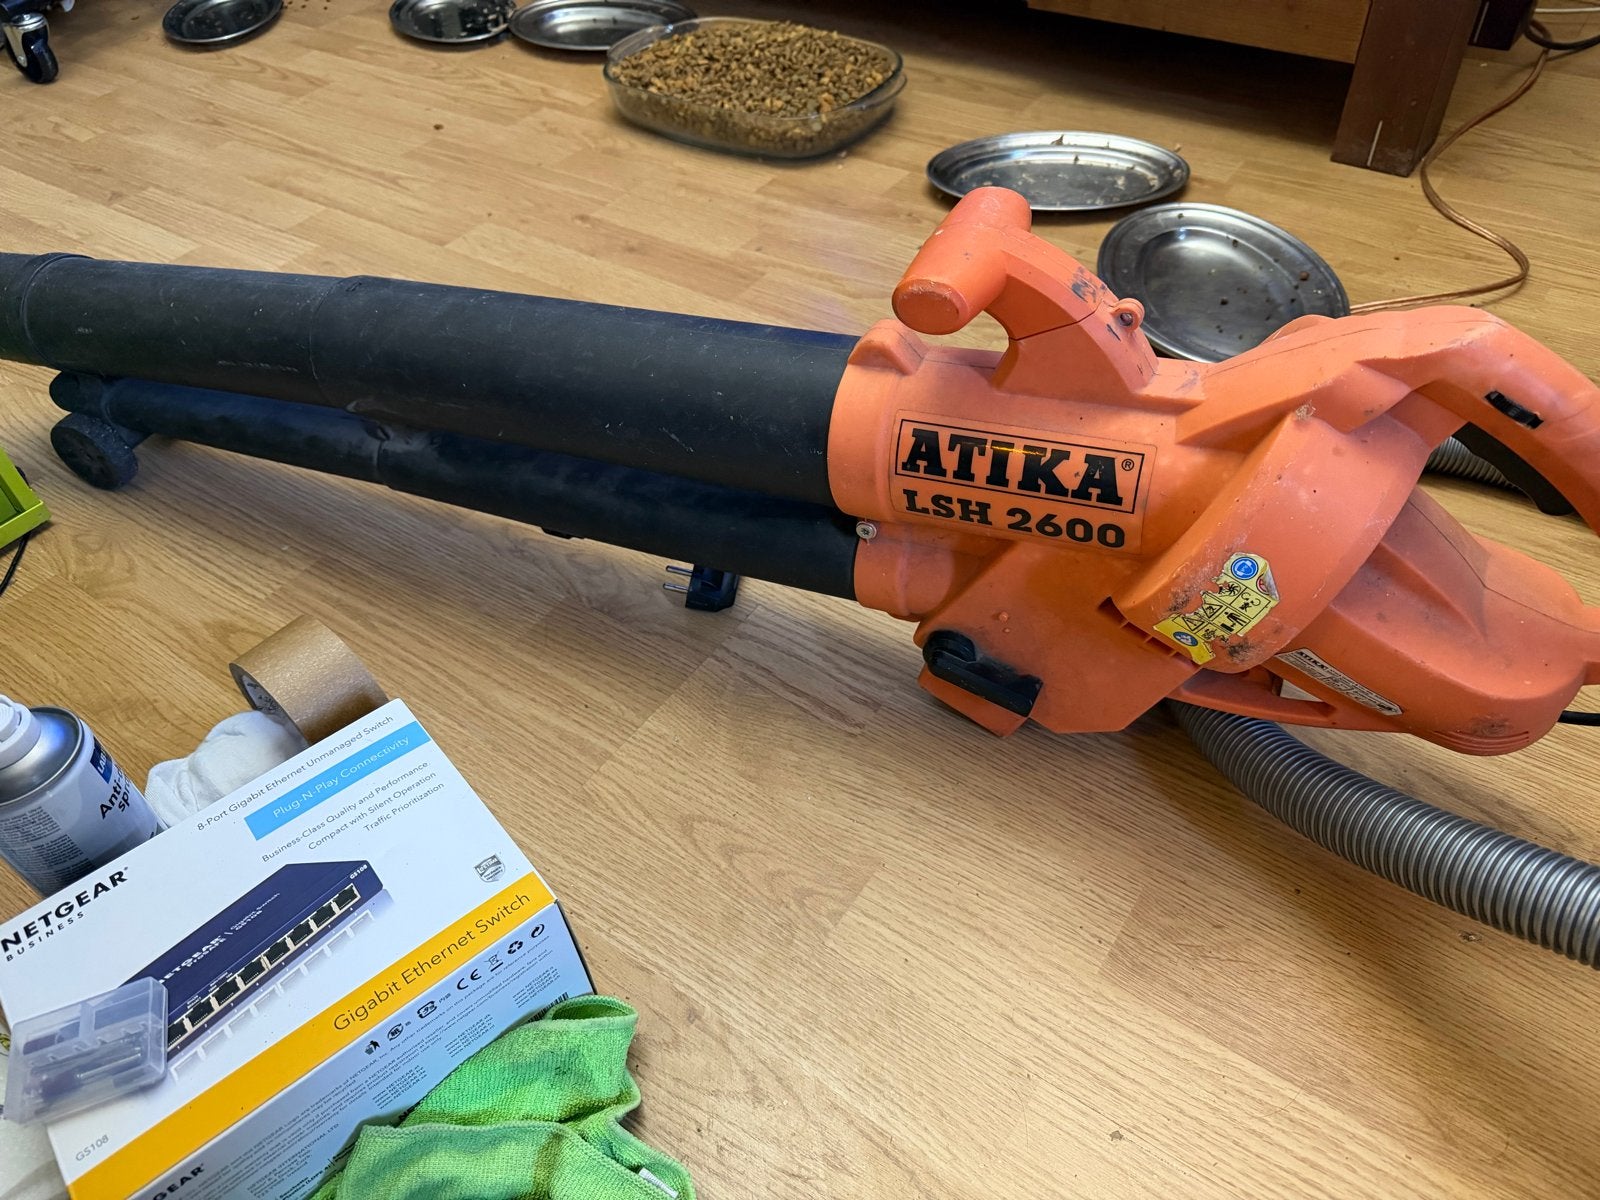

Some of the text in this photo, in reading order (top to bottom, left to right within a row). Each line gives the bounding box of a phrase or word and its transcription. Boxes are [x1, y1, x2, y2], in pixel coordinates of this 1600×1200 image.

[902, 488, 1125, 548] LSH 2600
[197, 715, 394, 831] 8-Port Gigabit Ethernet Unmanaged Switch
[273, 736, 410, 818] Plug-N-Play Connectivity
[364, 783, 445, 832] Traffic Prioritization
[262, 822, 326, 862] Business-Class
[326, 802, 357, 823] Quality
[358, 792, 375, 805] and
[308, 772, 437, 850] Compact with Silent Operation
[6, 911, 84, 962] BUSINESS
[333, 893, 531, 1032] Gigabit Ethernet Switch
[75, 1134, 110, 1163] GS108
